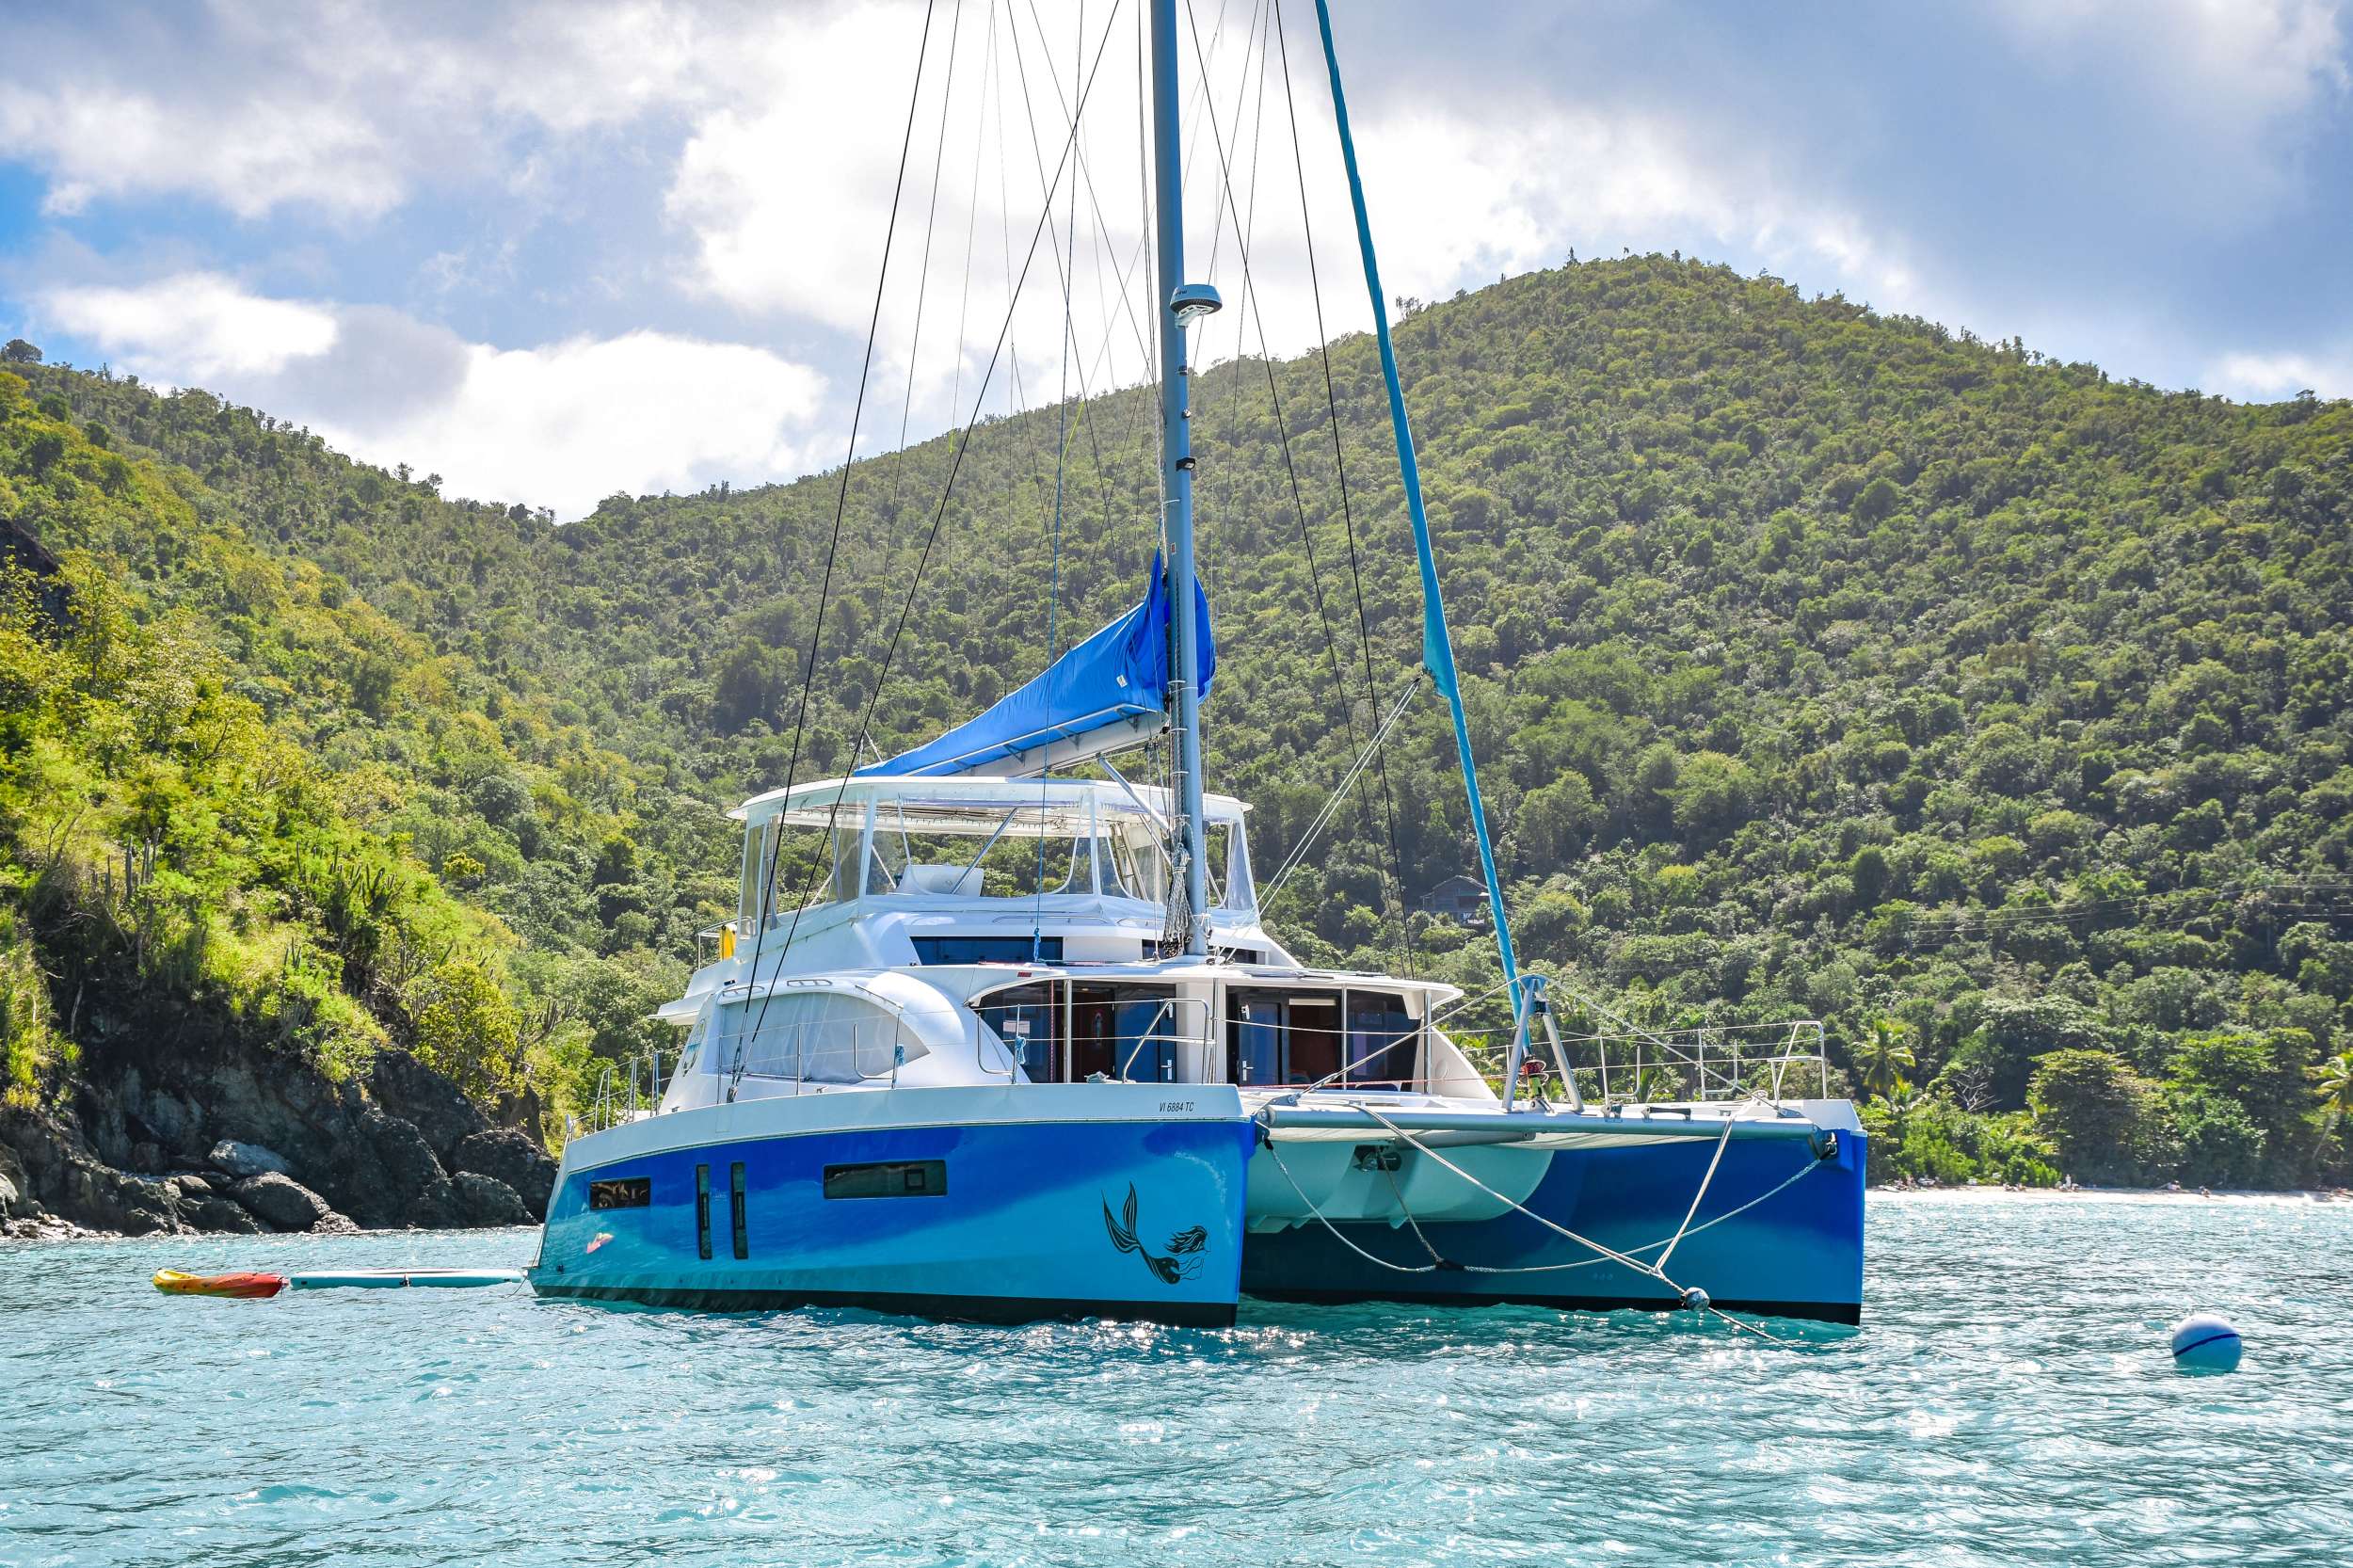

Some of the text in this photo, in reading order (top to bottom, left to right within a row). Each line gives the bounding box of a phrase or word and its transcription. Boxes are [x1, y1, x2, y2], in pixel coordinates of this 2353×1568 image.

[1160, 1102, 1194, 1112] VI 6884 TC
